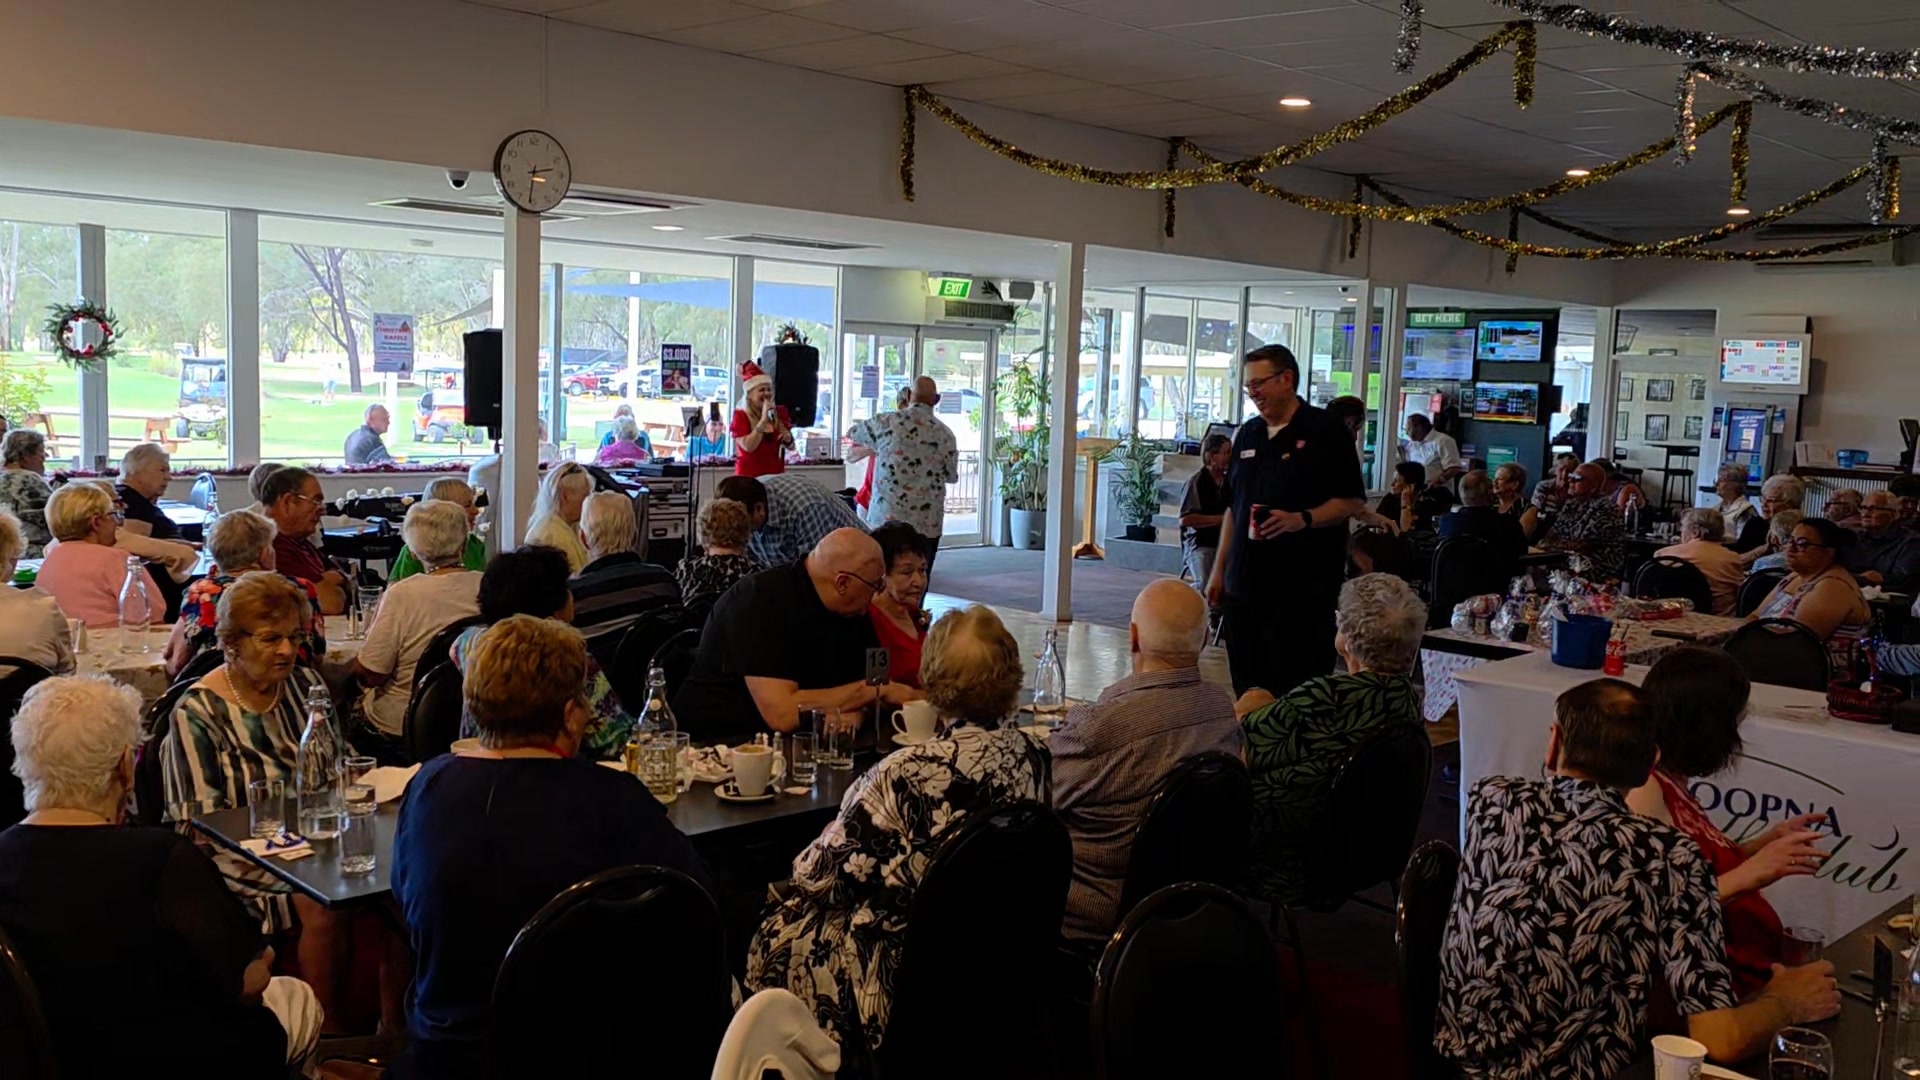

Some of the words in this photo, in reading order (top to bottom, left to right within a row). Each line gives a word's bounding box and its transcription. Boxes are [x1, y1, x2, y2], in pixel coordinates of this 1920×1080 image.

[516, 139, 524, 148] 11
[529, 136, 540, 146] 12
[507, 149, 518, 159] 10
[943, 281, 965, 296] EXIT
[1414, 312, 1433, 324] BET
[1435, 312, 1463, 324] HERE
[869, 650, 889, 668] 13
[1806, 834, 1909, 893] lub
